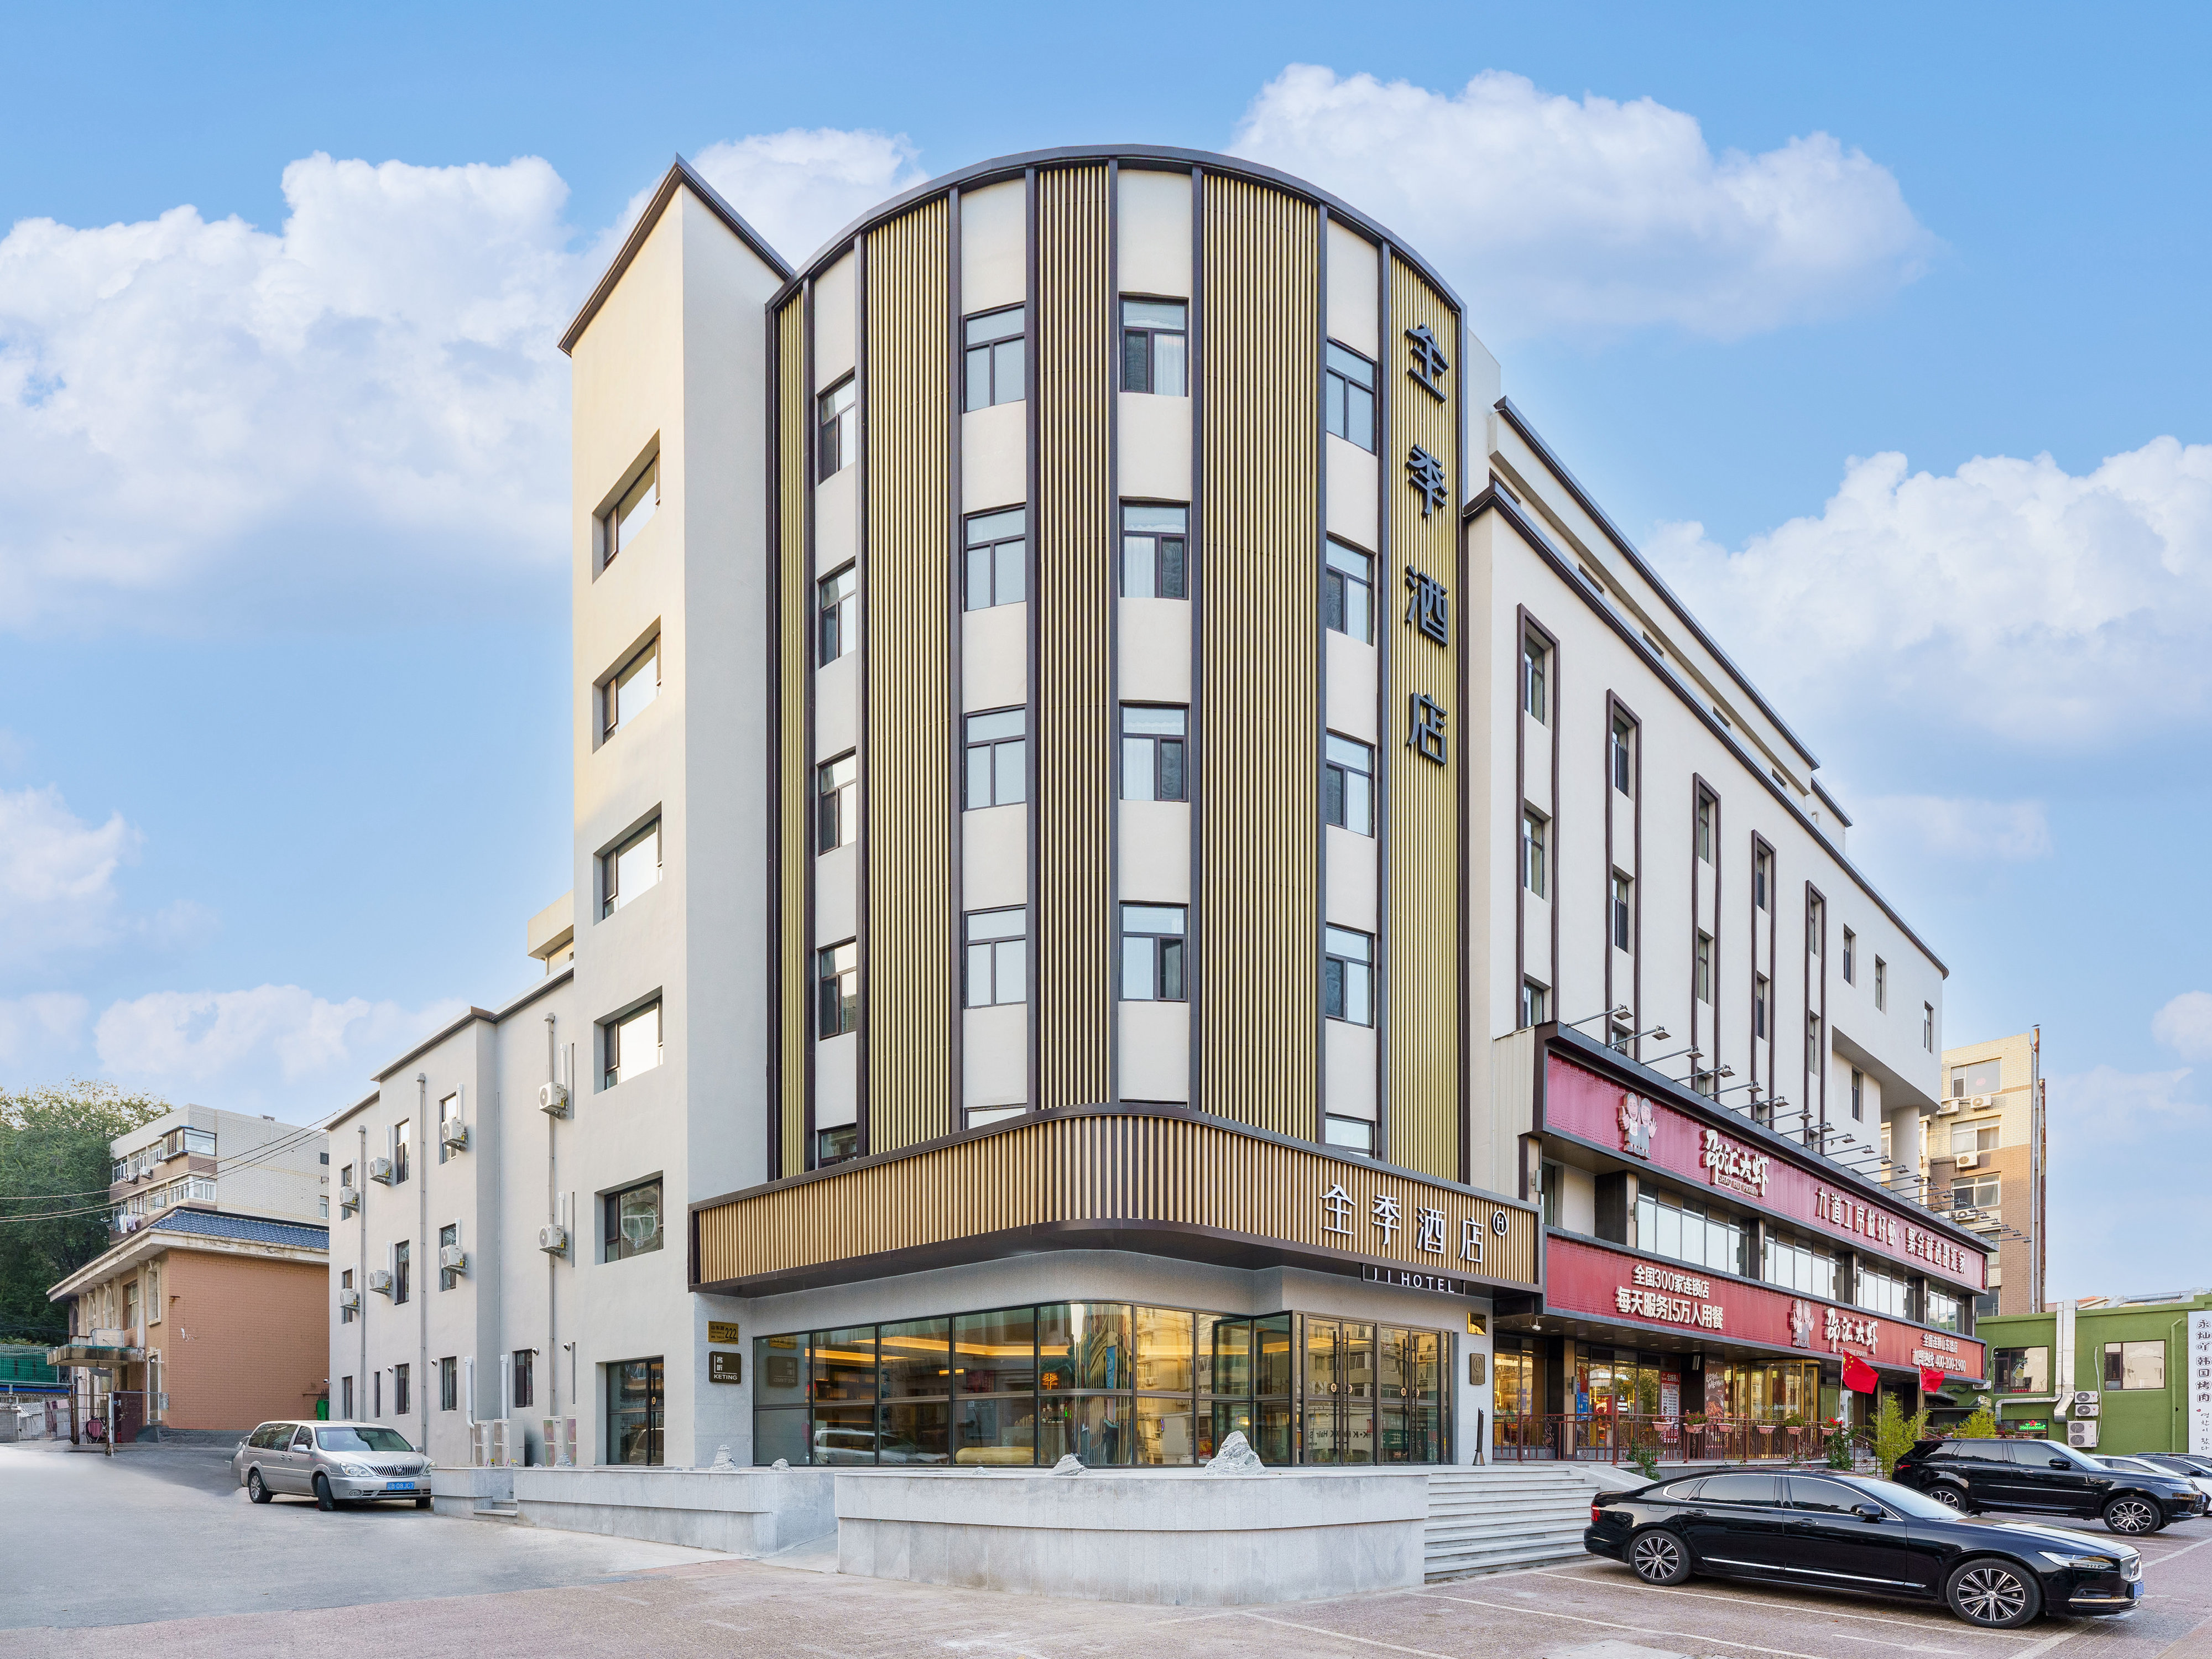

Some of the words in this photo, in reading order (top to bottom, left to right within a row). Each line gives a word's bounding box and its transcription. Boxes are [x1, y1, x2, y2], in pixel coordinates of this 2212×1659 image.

[1405, 323, 1449, 766] 全季酒店
[1744, 1185, 1758, 1196] PRAWN
[1321, 1184, 1485, 1264] 全季酒店
[1401, 1271, 1455, 1293] HOTEL
[1633, 1264, 1710, 1299] 全国300家连锁店
[1616, 1286, 1724, 1329] 每天服务15万人用餐
[725, 1327, 737, 1339] 222
[1935, 1354, 1966, 1372] 400-100-1900
